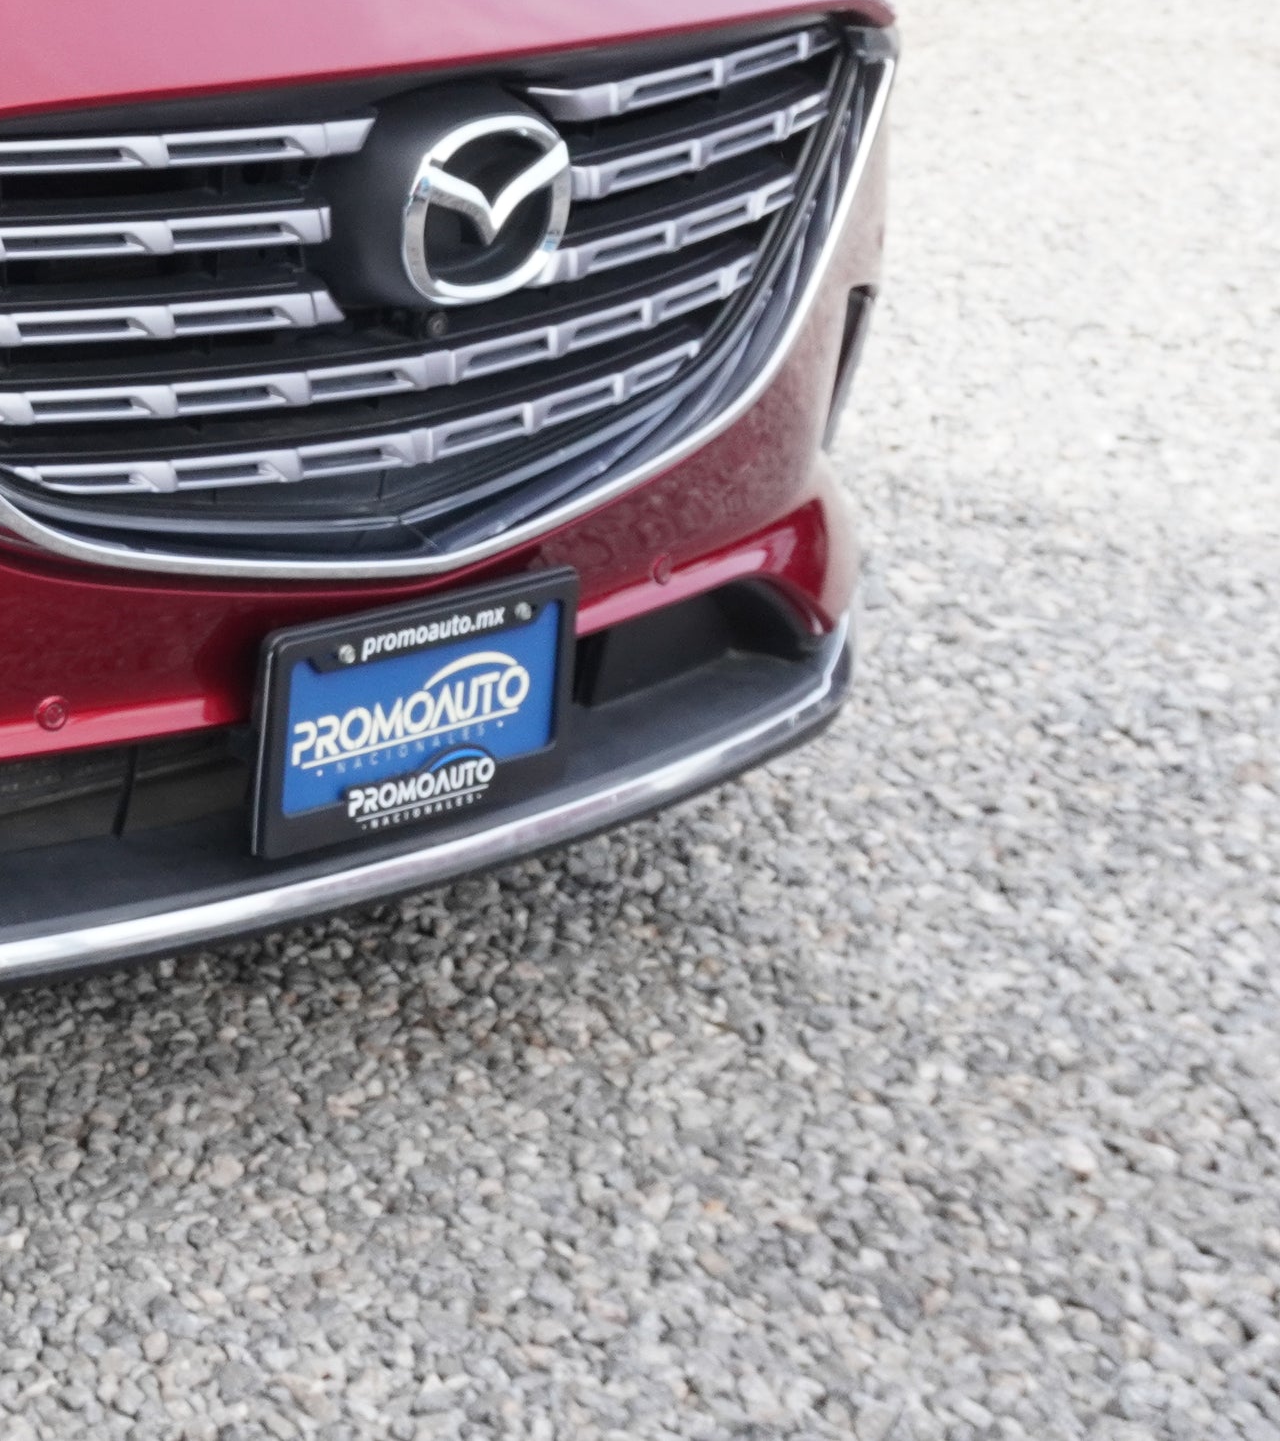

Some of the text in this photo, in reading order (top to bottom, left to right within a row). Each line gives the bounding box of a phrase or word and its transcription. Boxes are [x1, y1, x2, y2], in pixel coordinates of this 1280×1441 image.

[360, 606, 507, 662] promoauto.mx
[291, 664, 531, 767] PROMOAUTO
[336, 723, 486, 773] NACIONALES
[347, 756, 496, 818] PROMOAUTO
[369, 792, 475, 829] NACIONALES
